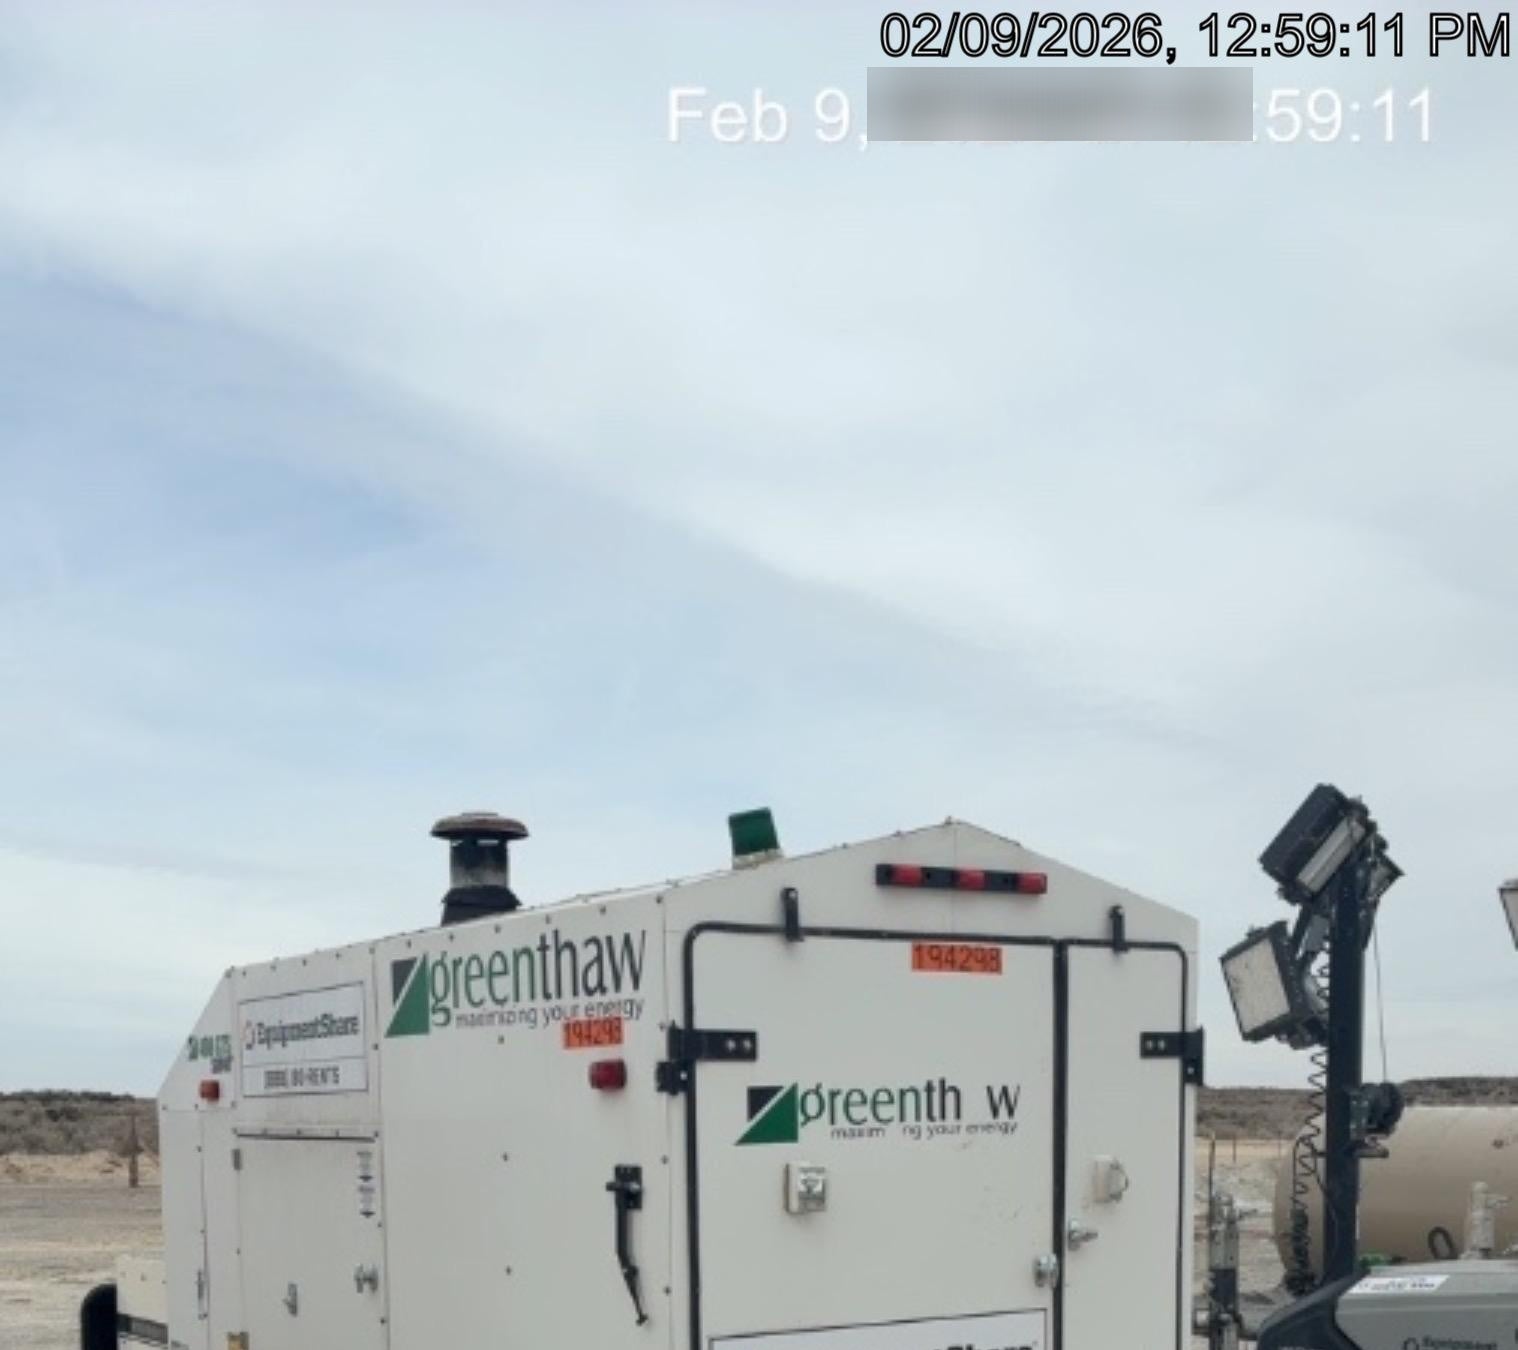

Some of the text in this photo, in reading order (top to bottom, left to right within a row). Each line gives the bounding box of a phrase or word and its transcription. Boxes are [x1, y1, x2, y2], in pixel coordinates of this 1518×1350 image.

[914, 943, 1002, 973] 194298
[430, 929, 647, 1027] greenthaw
[543, 999, 580, 1024] your
[800, 1077, 1021, 1128] greenthw
[928, 1122, 962, 1140] your
[965, 1120, 1018, 1137] energy
